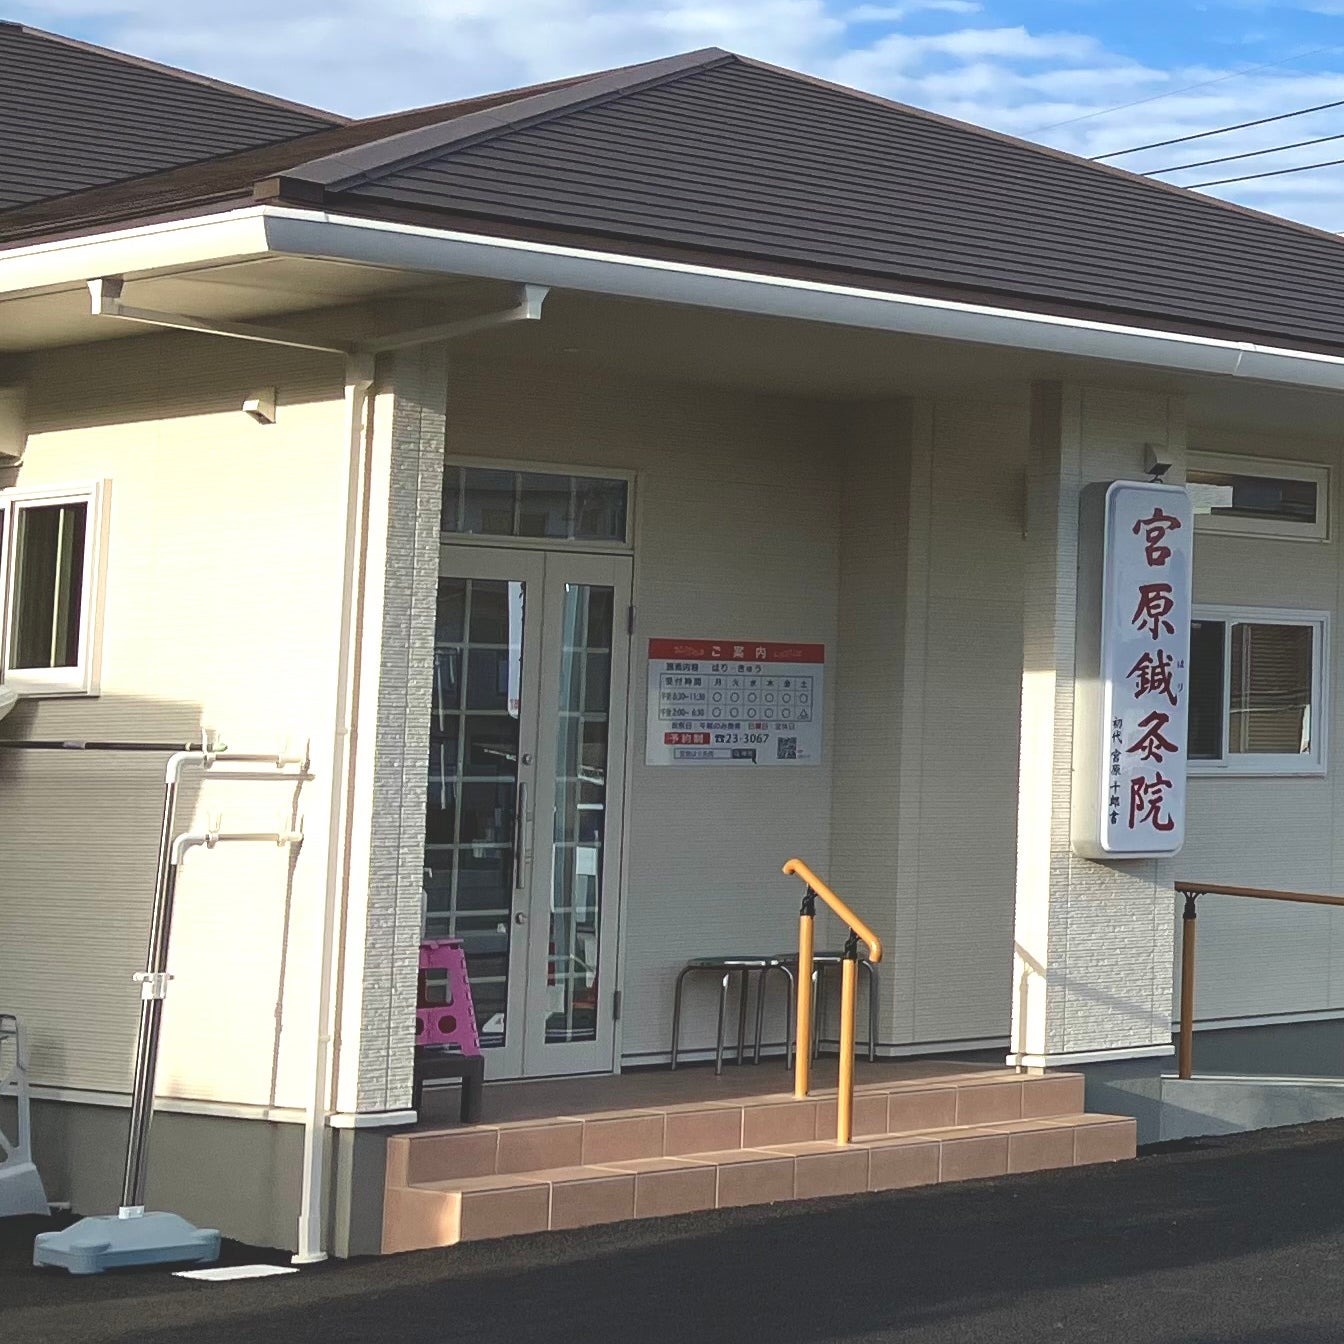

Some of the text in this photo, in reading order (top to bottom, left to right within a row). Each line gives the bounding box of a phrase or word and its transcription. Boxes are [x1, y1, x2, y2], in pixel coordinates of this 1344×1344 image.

[711, 645, 767, 660] ご案内
[1126, 507, 1182, 833] 宮原鍼灸院
[669, 733, 704, 744] 予約制
[1110, 748, 1122, 776] 宮原
